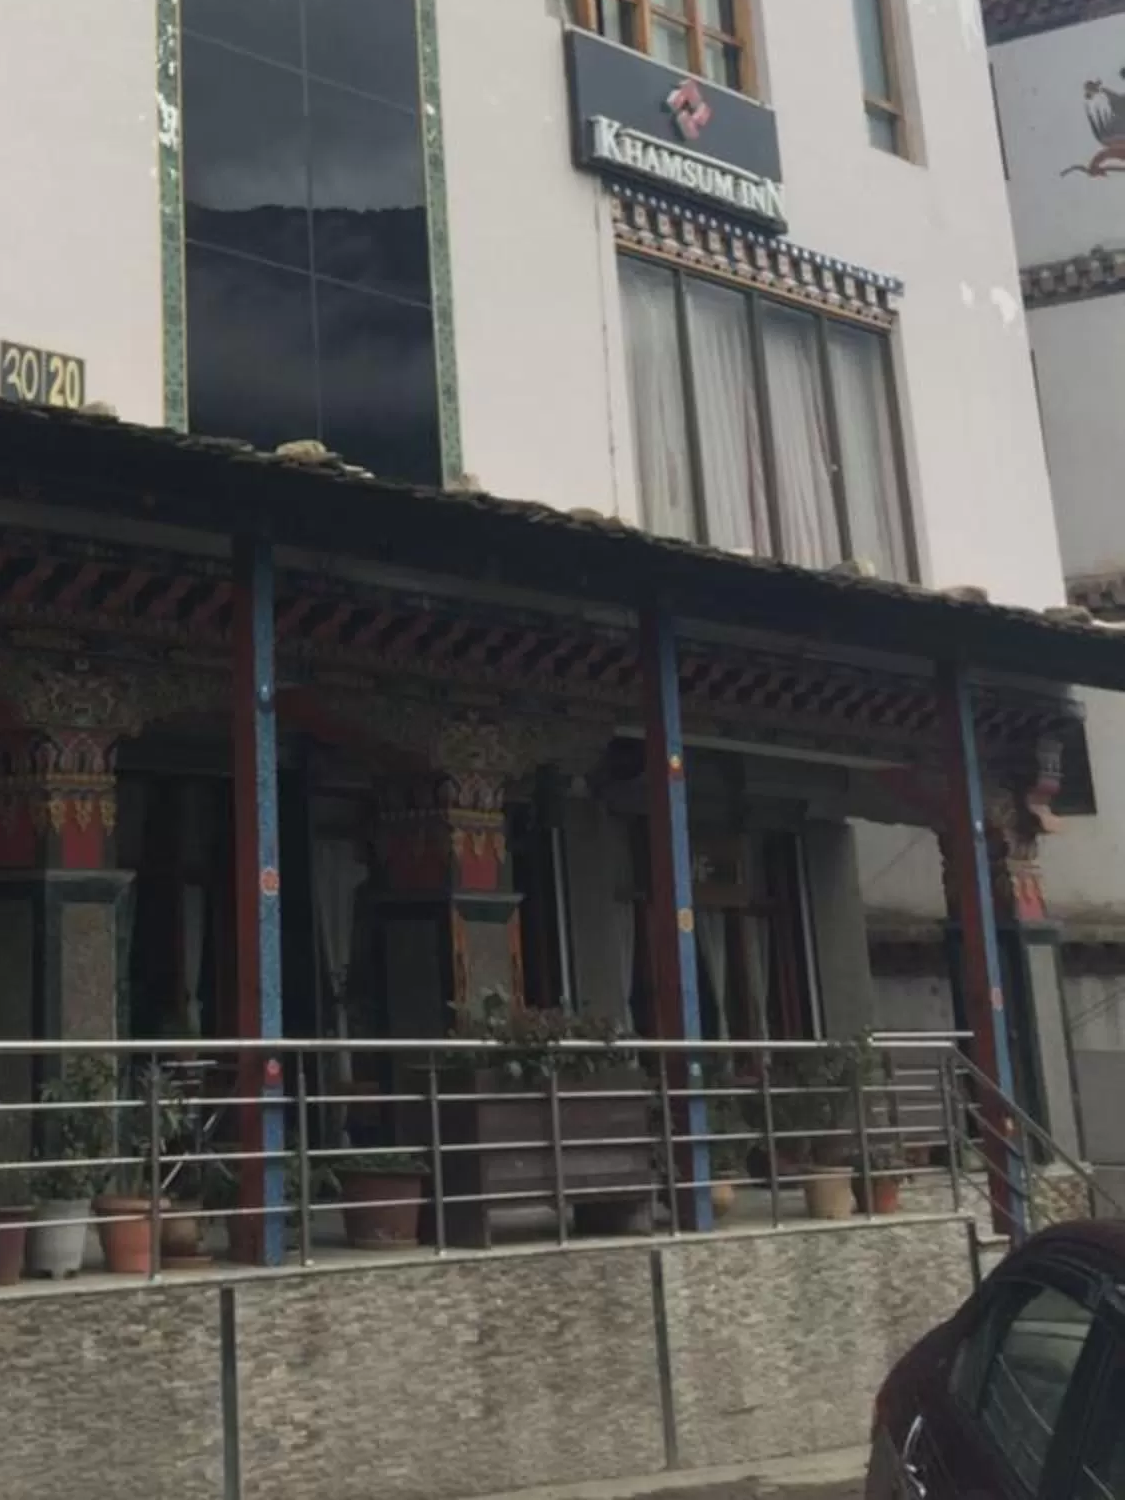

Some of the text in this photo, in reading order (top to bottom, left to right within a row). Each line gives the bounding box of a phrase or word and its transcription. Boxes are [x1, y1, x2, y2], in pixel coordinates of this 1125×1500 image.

[589, 115, 785, 221] KHAMSUM INN
[49, 355, 81, 410] 20
